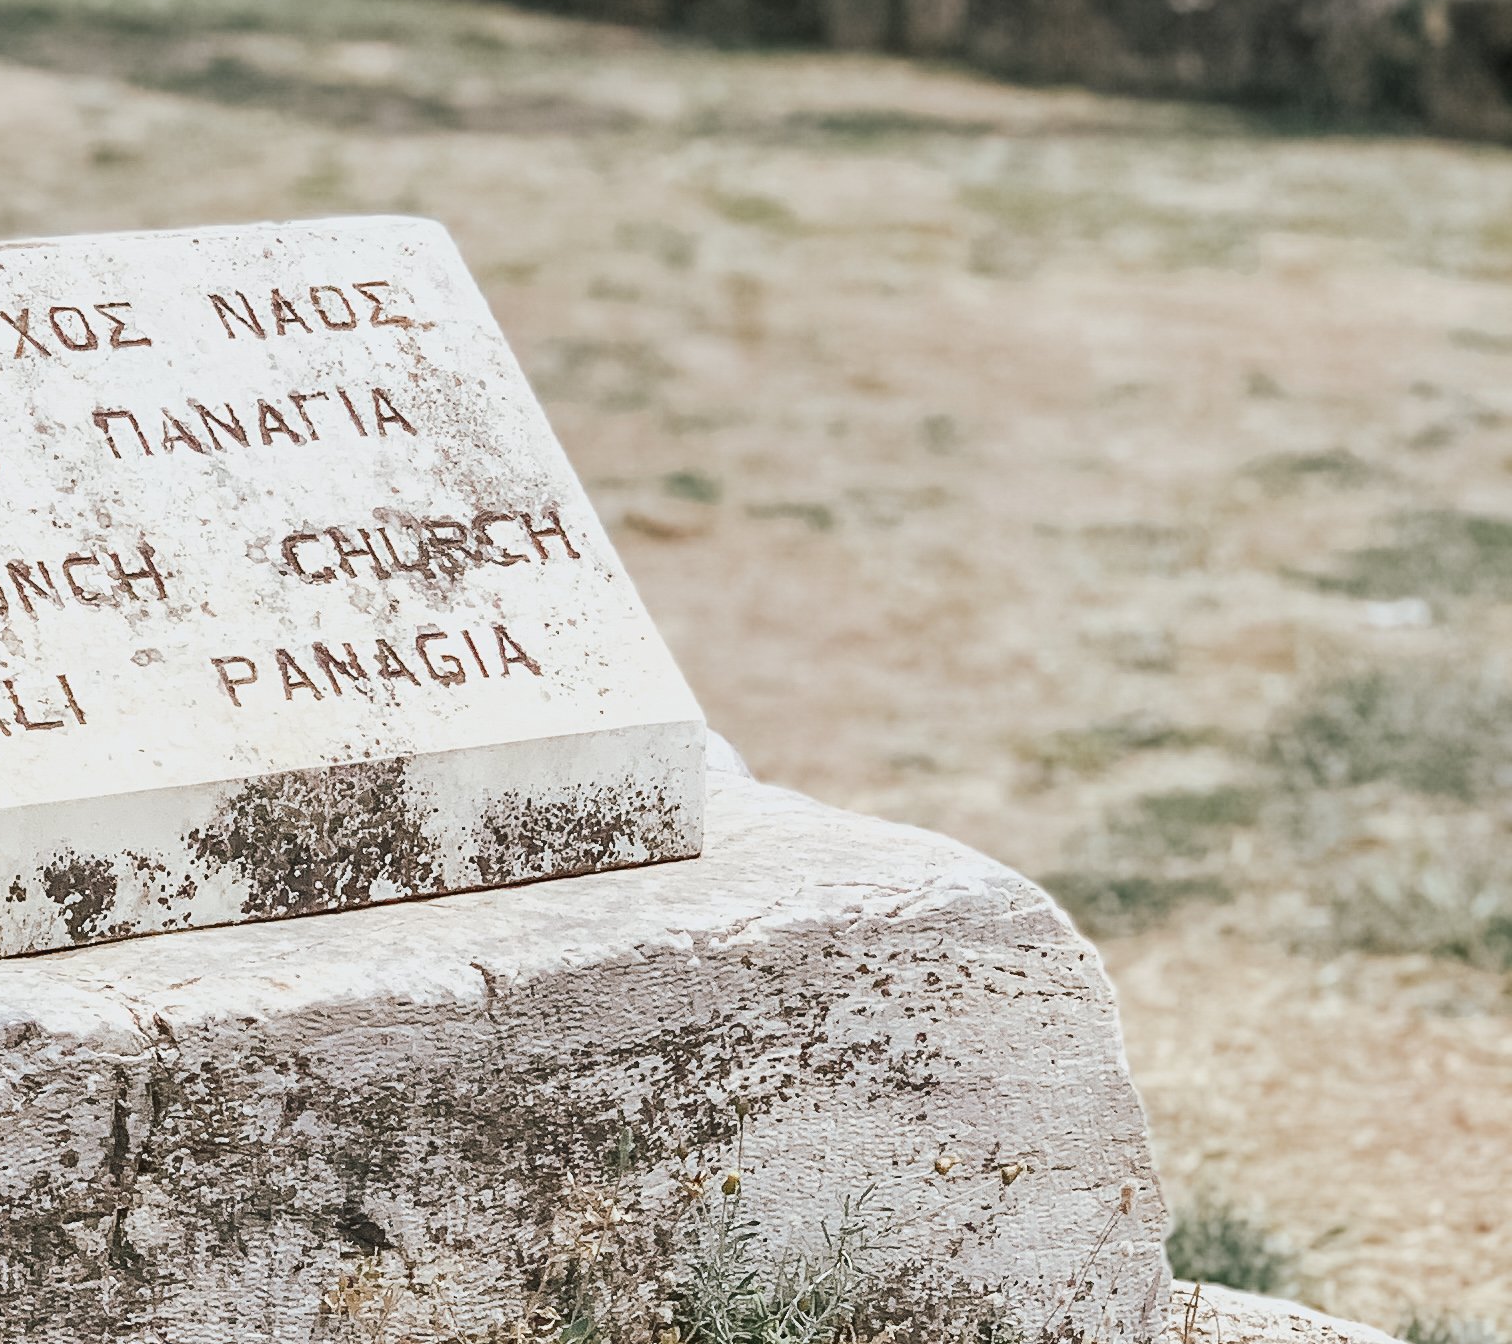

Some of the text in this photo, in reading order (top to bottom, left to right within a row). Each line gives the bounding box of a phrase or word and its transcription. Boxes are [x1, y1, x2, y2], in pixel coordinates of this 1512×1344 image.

[208, 280, 423, 341] ΝΑΟΣ
[93, 387, 418, 460] ΠΑΝΑΓΙΑ
[280, 507, 581, 583] CHURCH
[211, 624, 543, 707] PANAGIA
